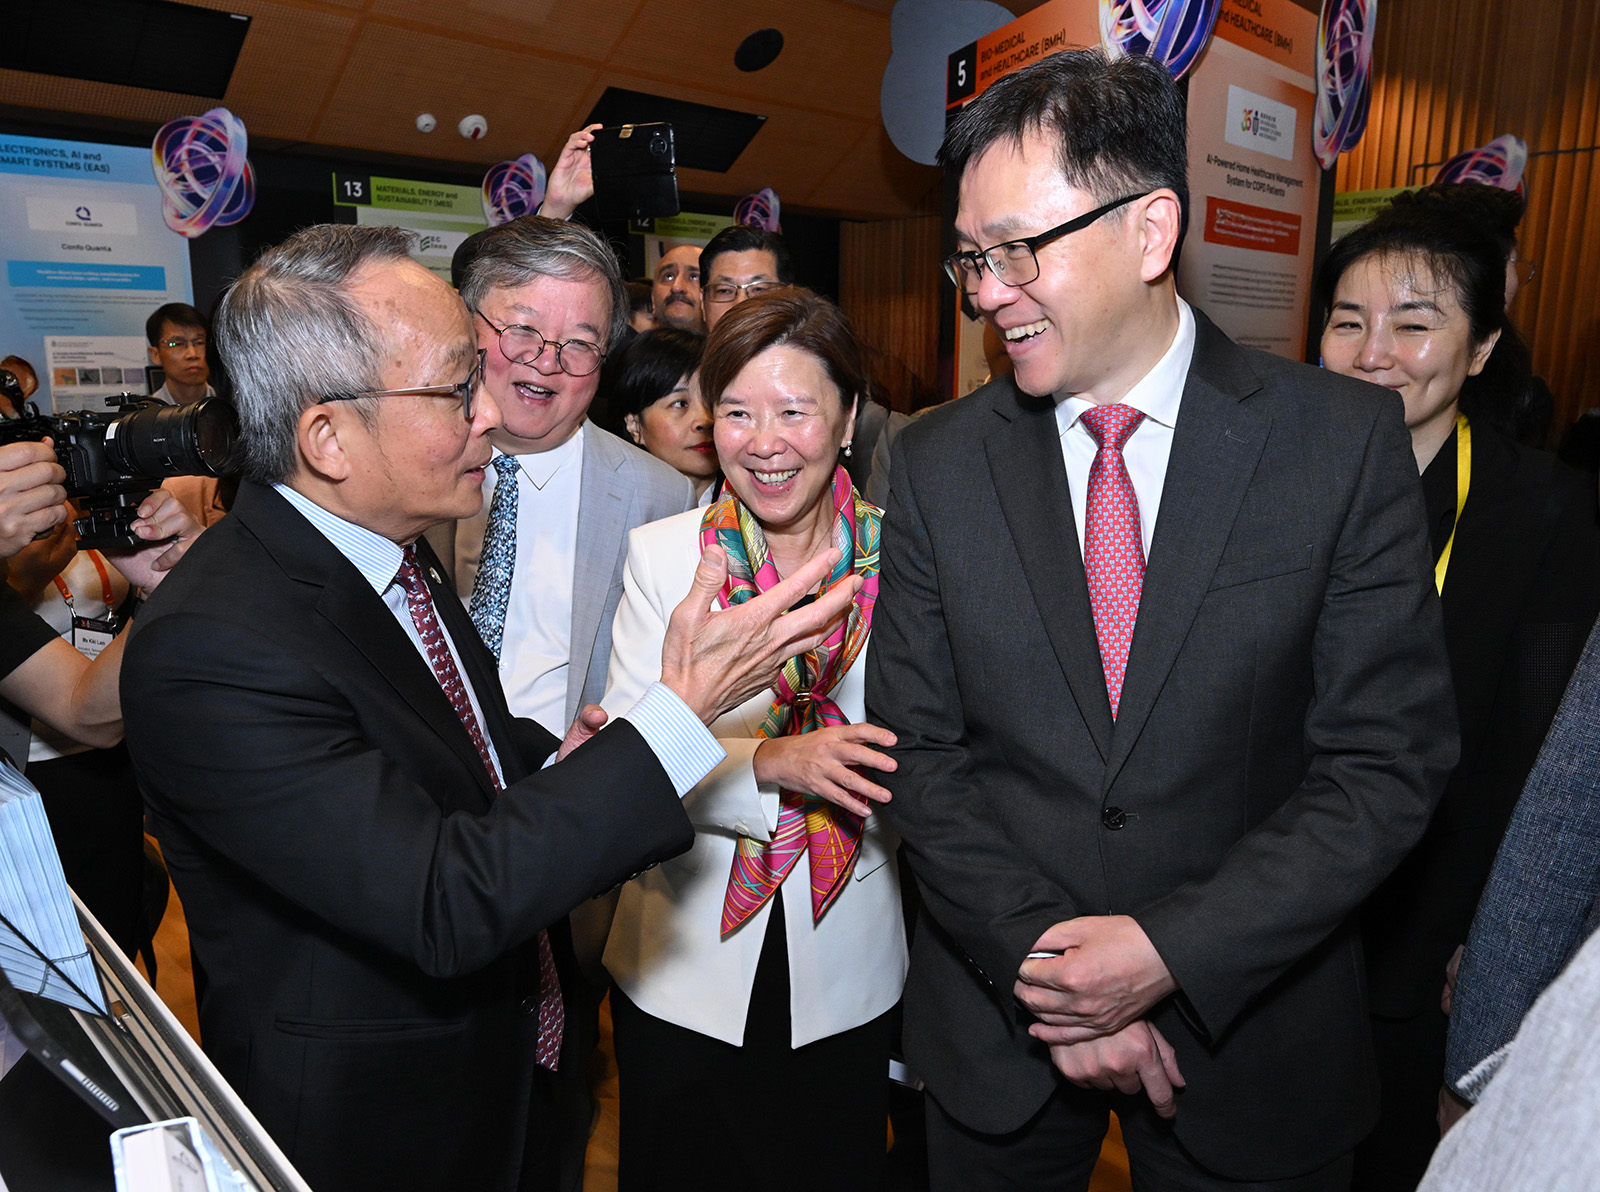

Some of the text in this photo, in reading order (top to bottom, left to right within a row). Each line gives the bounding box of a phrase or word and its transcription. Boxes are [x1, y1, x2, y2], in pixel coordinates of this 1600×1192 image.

[1230, 11, 1273, 44] HEALTHCARE
[1274, 31, 1293, 54] (BMH)
[980, 28, 1066, 80] and HEALTHCARE (BMH)
[981, 32, 1025, 63] BIO-MEDICAL
[958, 59, 966, 87] 5
[0, 144, 69, 159] LECTRONICS,
[83, 152, 102, 161] and
[0, 156, 110, 174] MART SYSTEMS (EAS)
[1207, 153, 1236, 171] AI-Powered
[1236, 162, 1250, 174] Home
[1250, 166, 1275, 181] Healthcare
[344, 181, 363, 198] 13
[1226, 173, 1245, 187] System
[1252, 180, 1266, 192] COPD
[377, 195, 453, 209] SUSTAINABILITY (MES)
[418, 188, 445, 198] ENERGY
[445, 189, 459, 199] and
